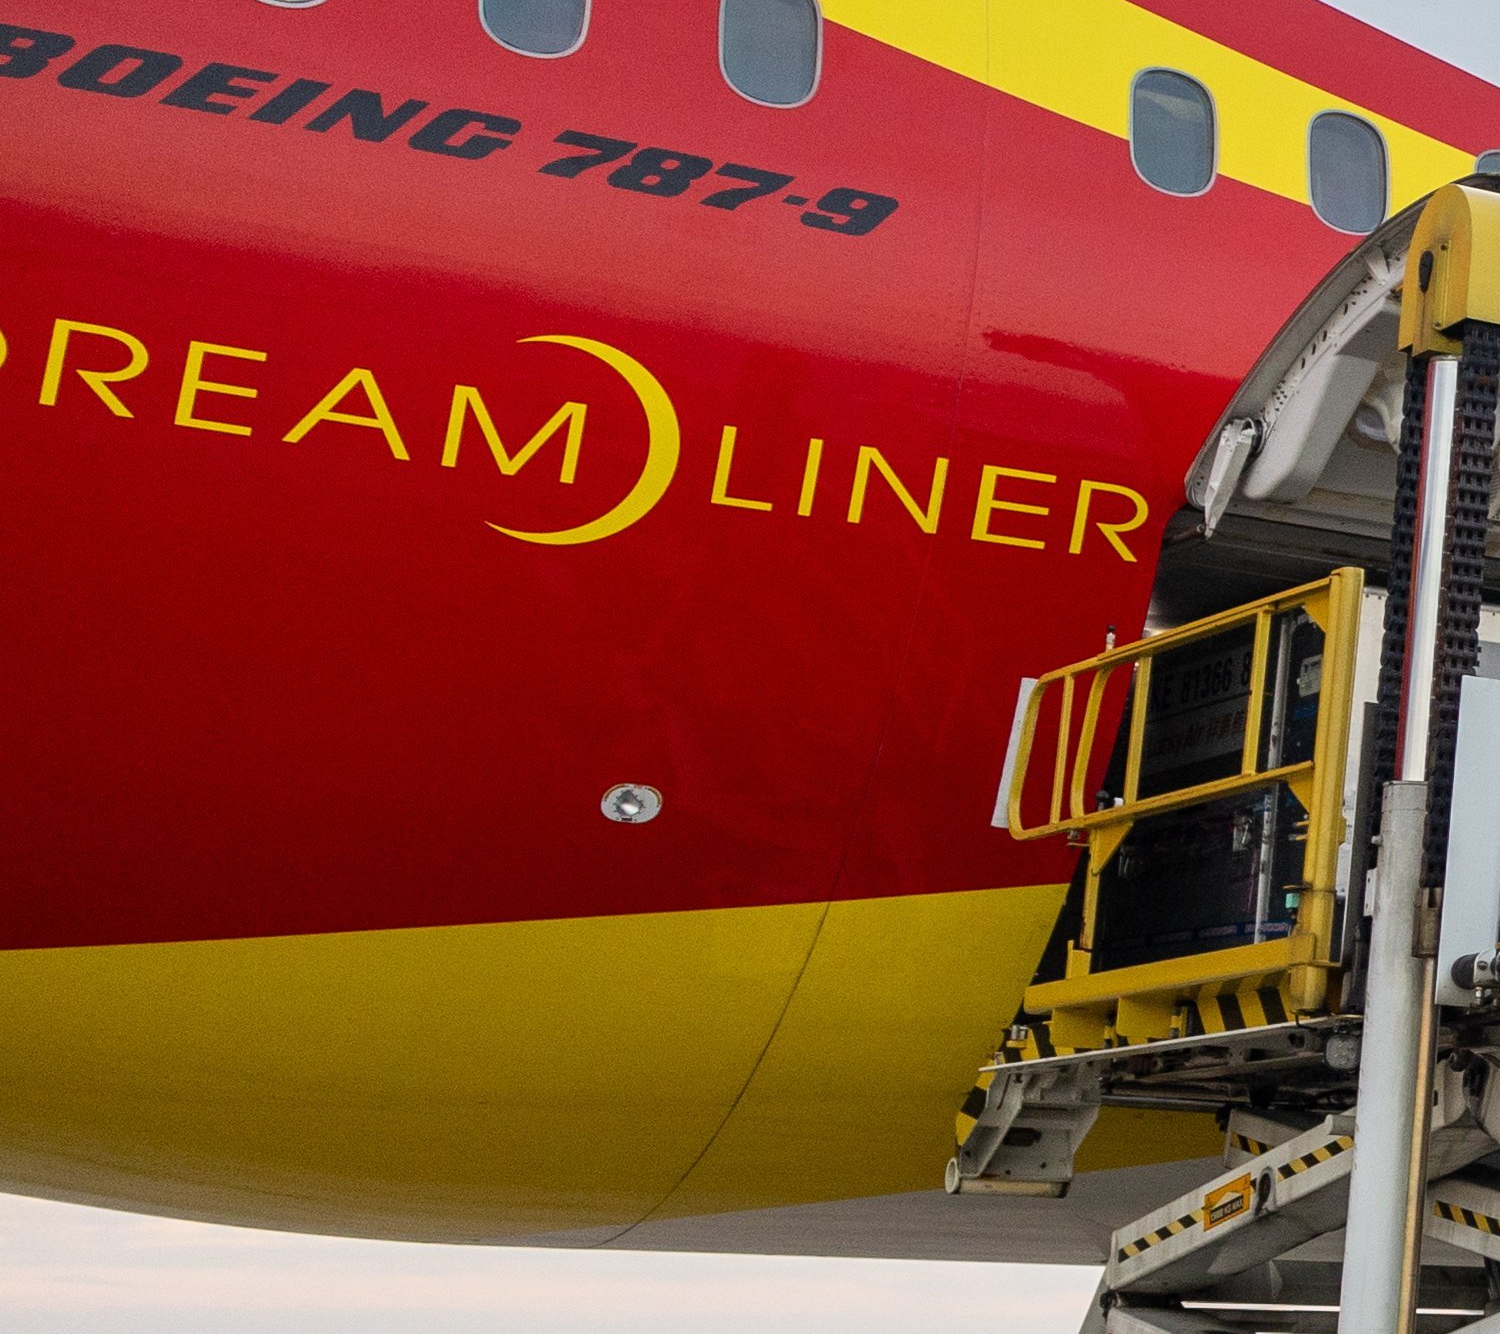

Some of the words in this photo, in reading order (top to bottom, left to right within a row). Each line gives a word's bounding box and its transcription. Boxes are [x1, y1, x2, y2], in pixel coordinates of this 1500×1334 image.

[0, 23, 520, 162] BOEING
[538, 130, 899, 236] 787-9
[0, 318, 589, 486] REAM
